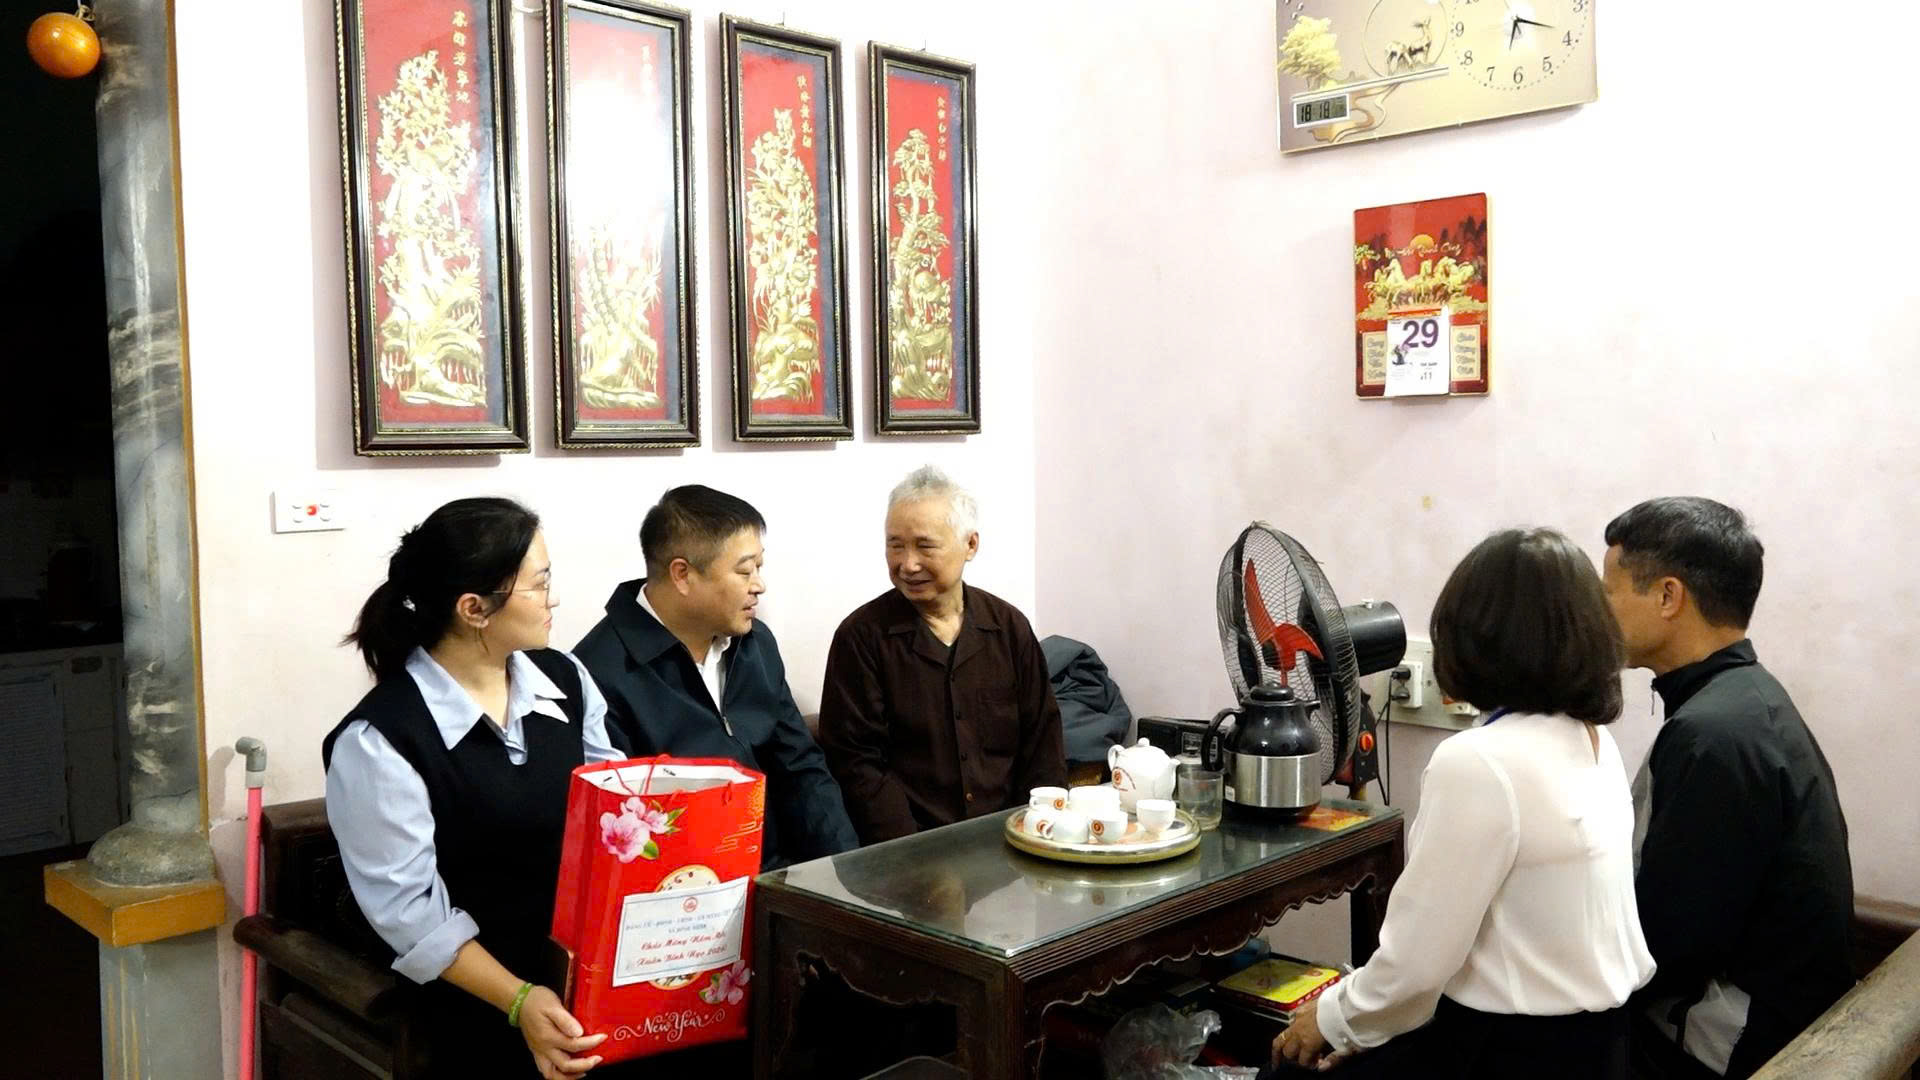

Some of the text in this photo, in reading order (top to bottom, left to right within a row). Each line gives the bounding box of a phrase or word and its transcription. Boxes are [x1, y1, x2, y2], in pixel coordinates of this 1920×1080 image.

[1573, 0, 1584, 13] 3
[1455, 21, 1465, 37] 9
[1562, 30, 1573, 46] 4
[1463, 50, 1473, 66] 8
[1542, 56, 1552, 72] 5
[1486, 66, 1495, 82] 7
[1513, 66, 1523, 84] 6
[1402, 319, 1439, 348] 29
[644, 1009, 703, 1042] New Year
